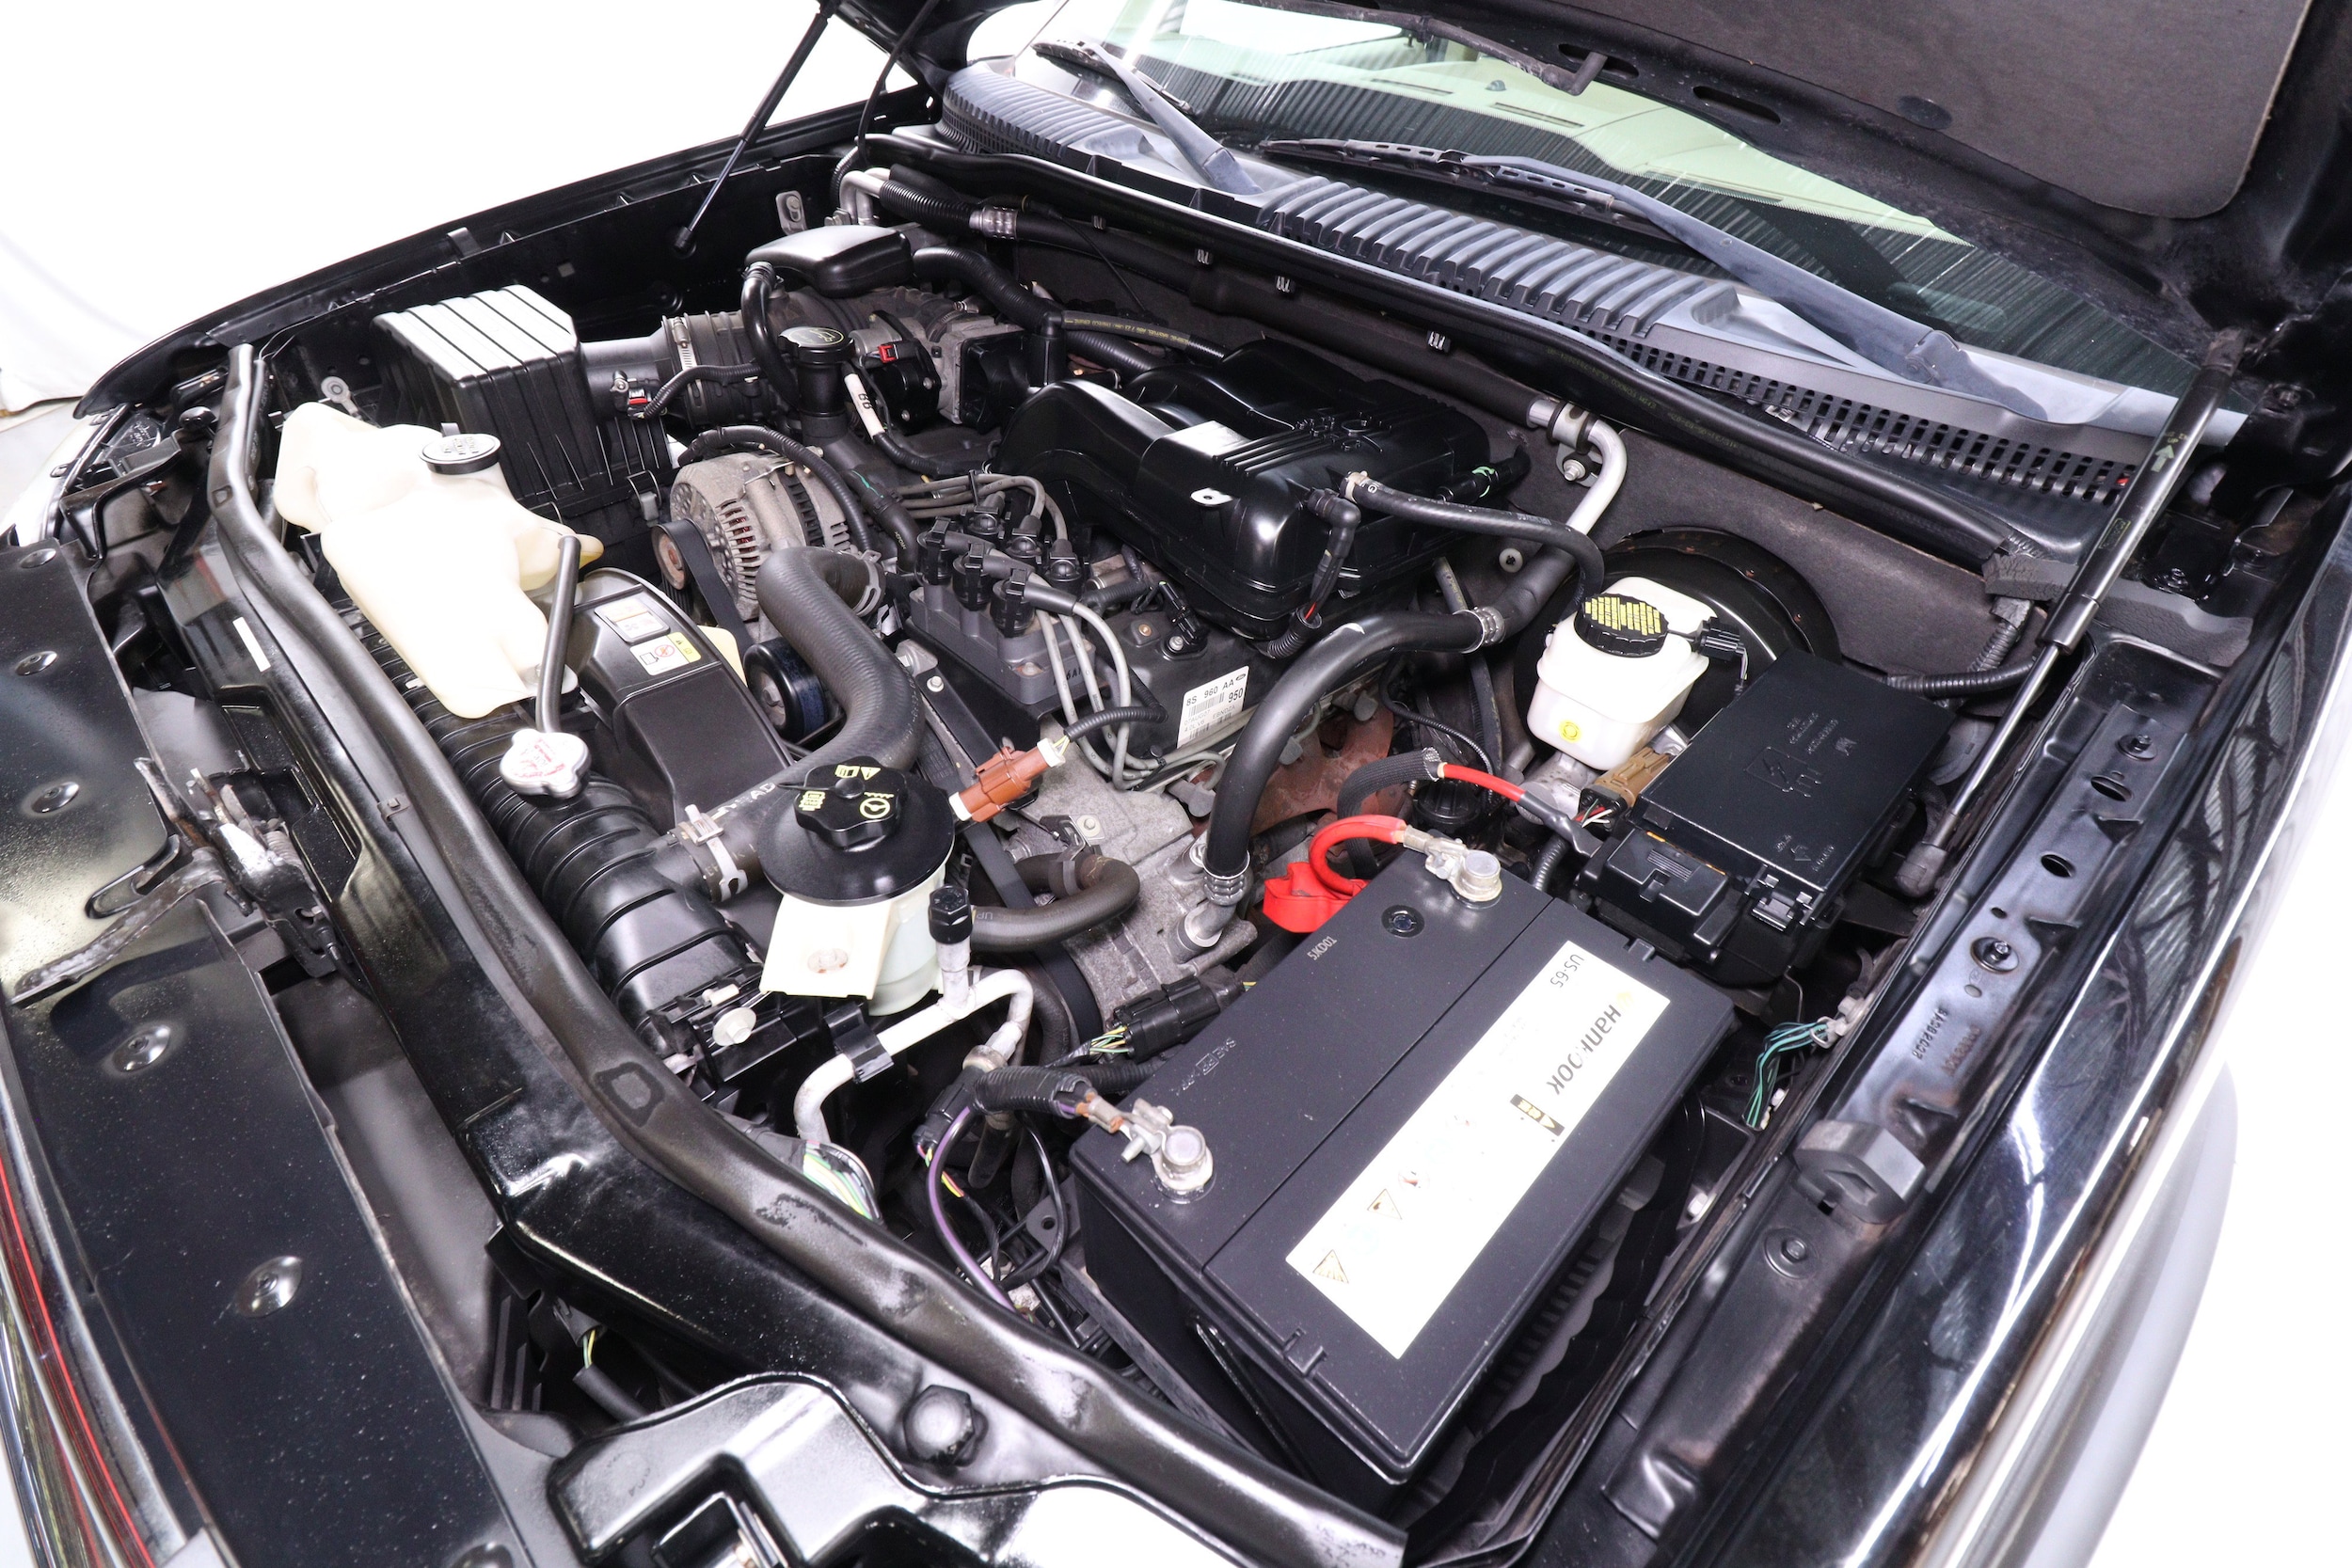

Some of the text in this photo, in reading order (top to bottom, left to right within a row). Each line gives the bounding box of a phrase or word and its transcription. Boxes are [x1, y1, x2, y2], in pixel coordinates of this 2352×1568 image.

[1203, 686, 1218, 700] 960
[1222, 678, 1234, 692] AA
[1228, 688, 1244, 704] 950
